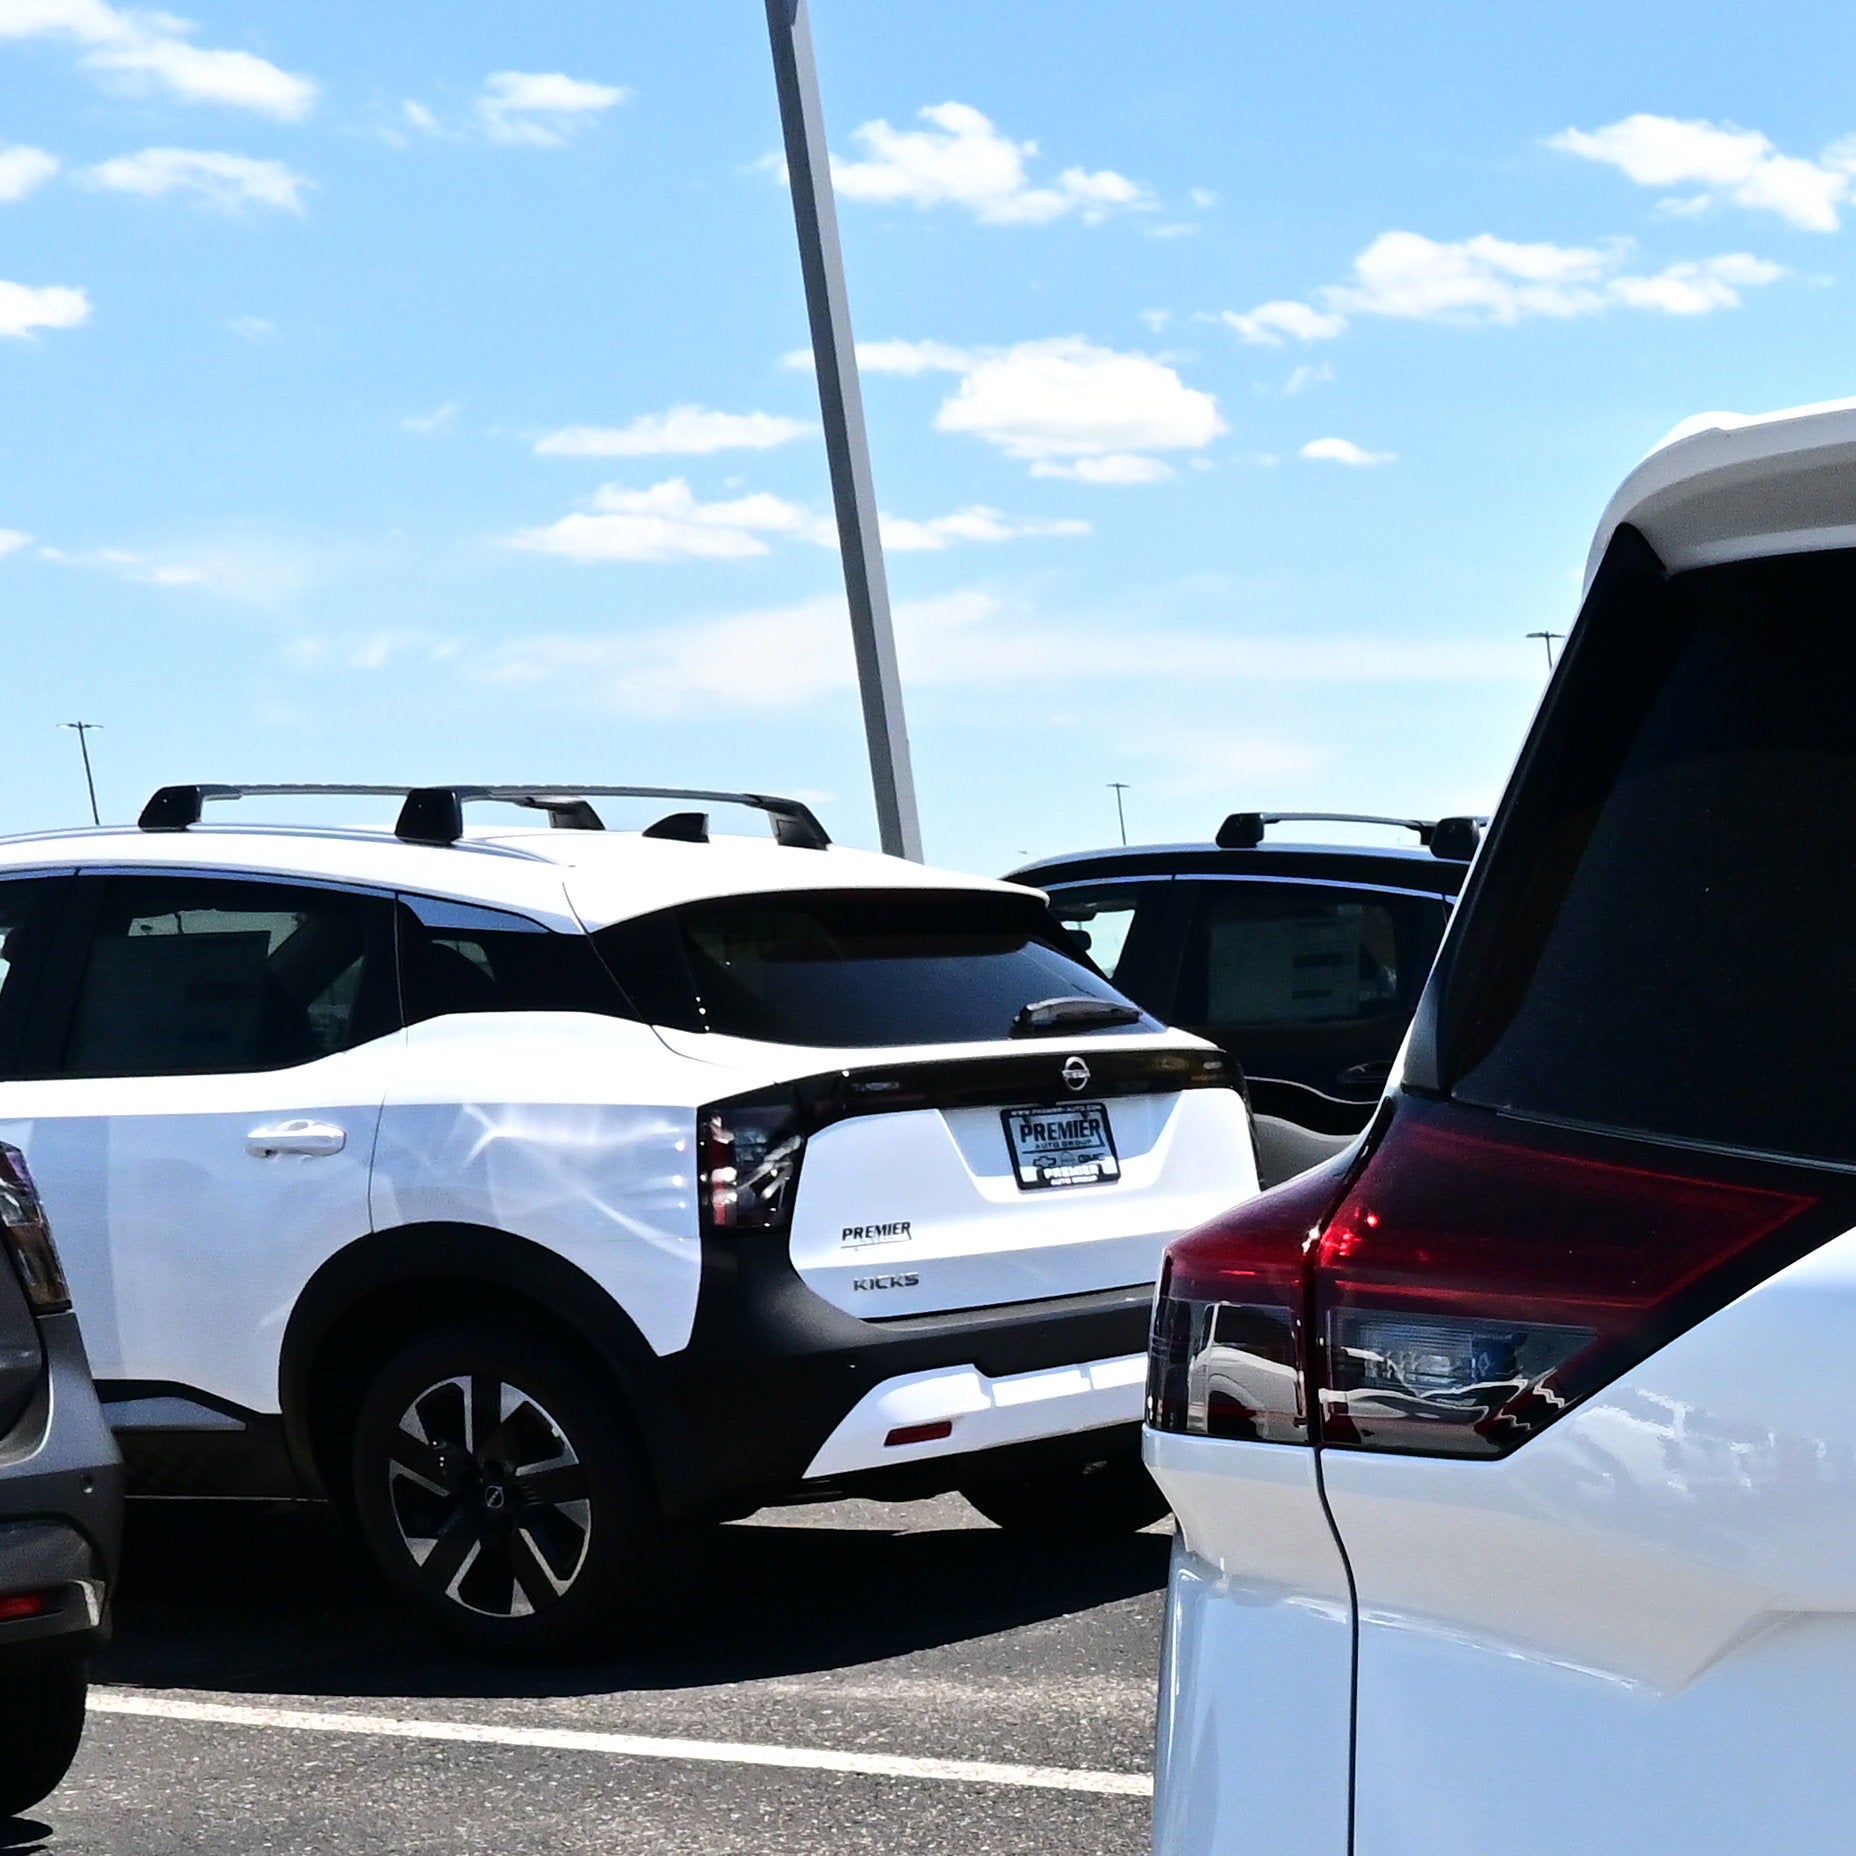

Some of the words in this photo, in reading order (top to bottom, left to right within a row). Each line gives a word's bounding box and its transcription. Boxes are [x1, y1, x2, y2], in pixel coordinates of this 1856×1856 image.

[1020, 1118, 1103, 1144] PREMIER
[1062, 1139, 1092, 1147] GROUP
[842, 1221, 911, 1241] PREMIER
[853, 1272, 920, 1291] KICKS
